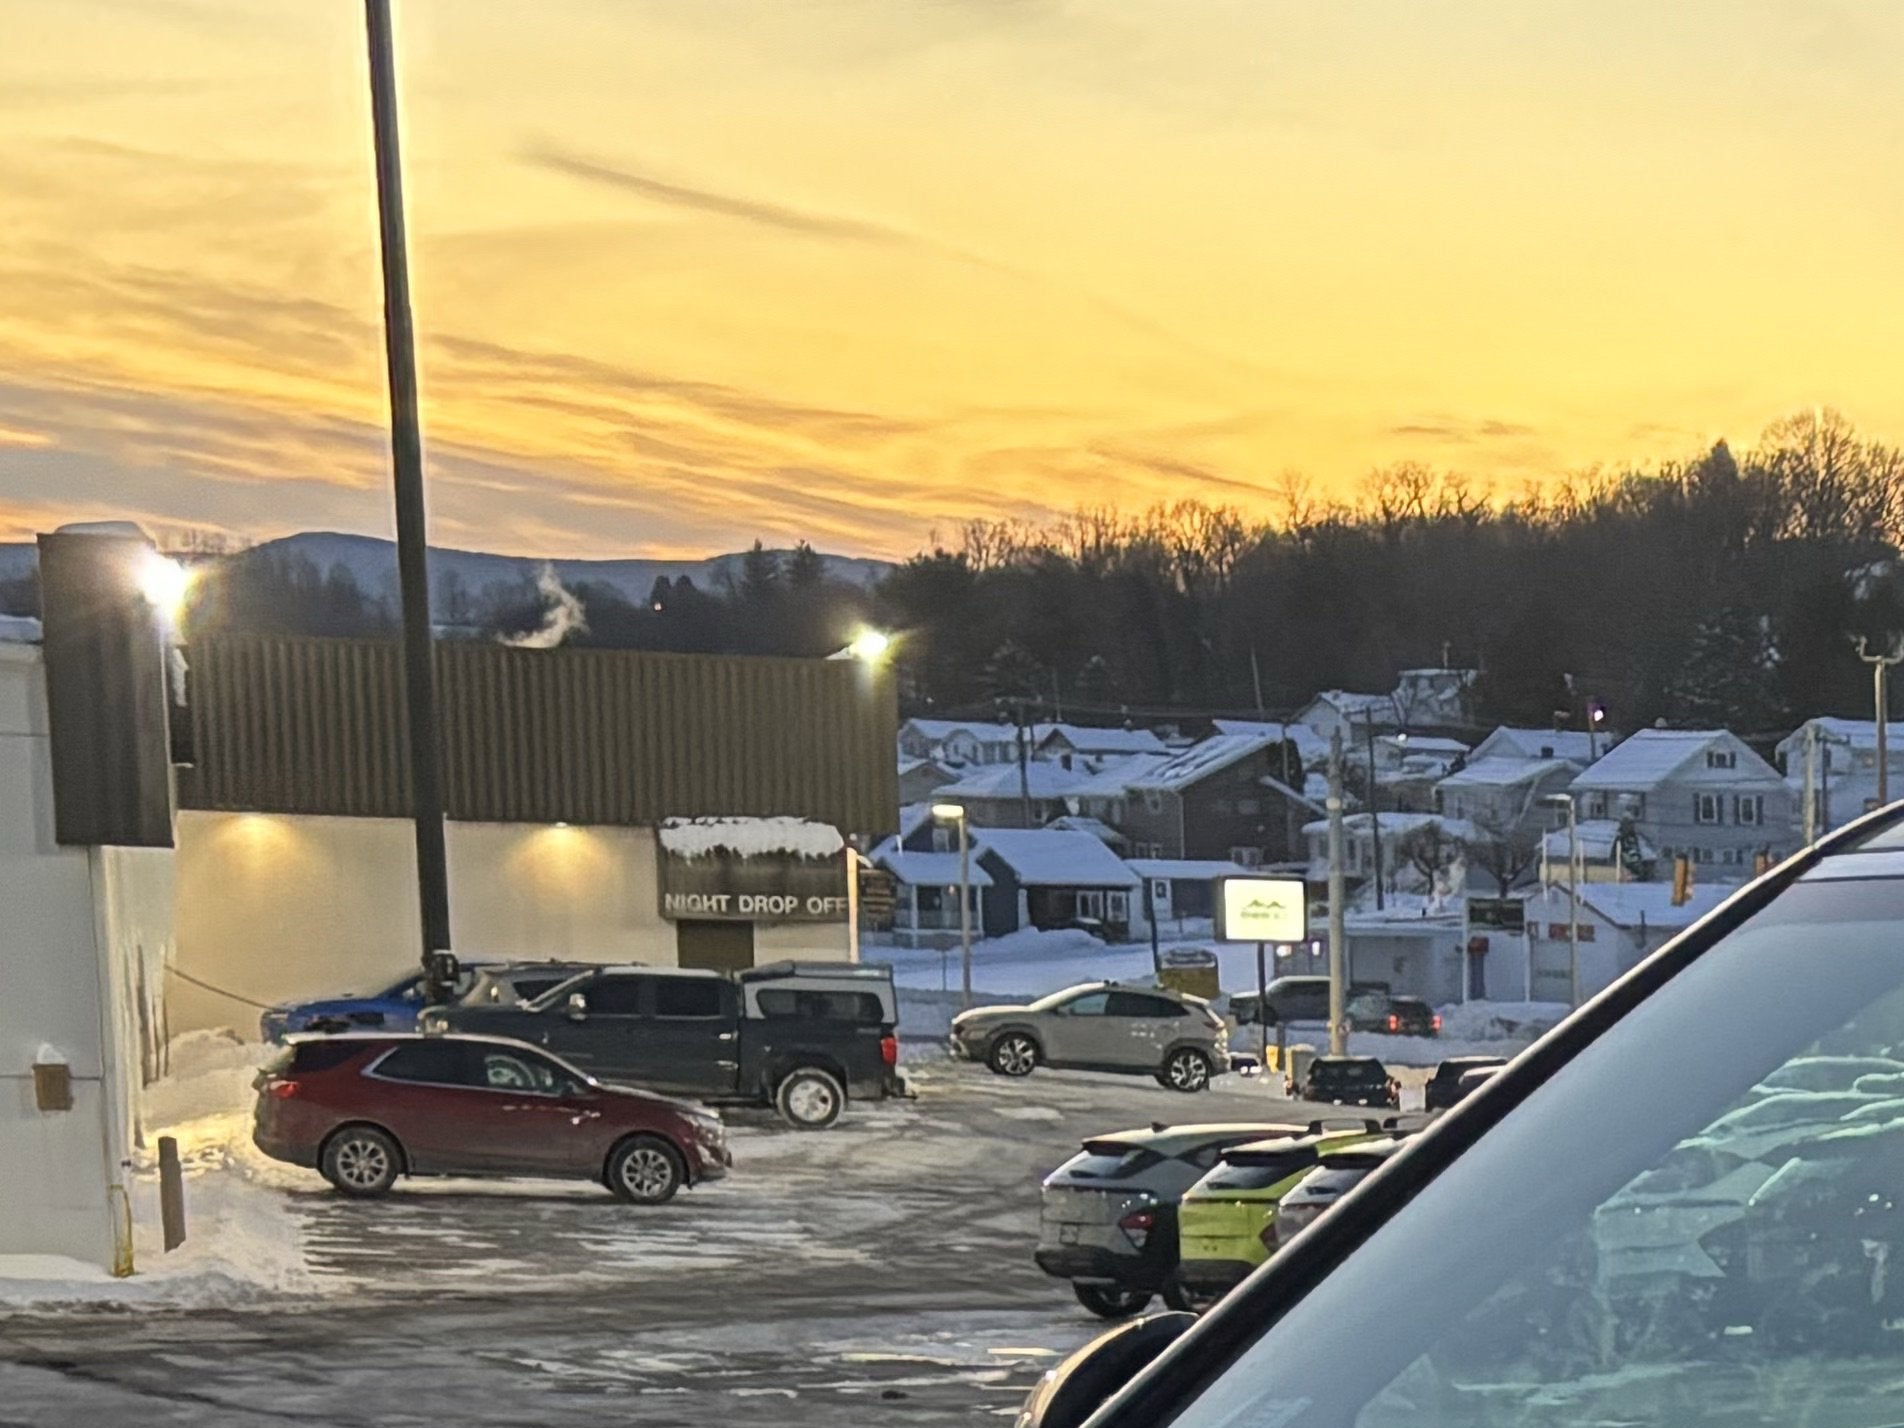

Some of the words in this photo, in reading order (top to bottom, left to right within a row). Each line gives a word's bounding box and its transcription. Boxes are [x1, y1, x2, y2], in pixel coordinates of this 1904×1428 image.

[664, 892, 731, 913] NIGHT
[738, 895, 799, 915] DROP
[806, 896, 849, 916] OFF
